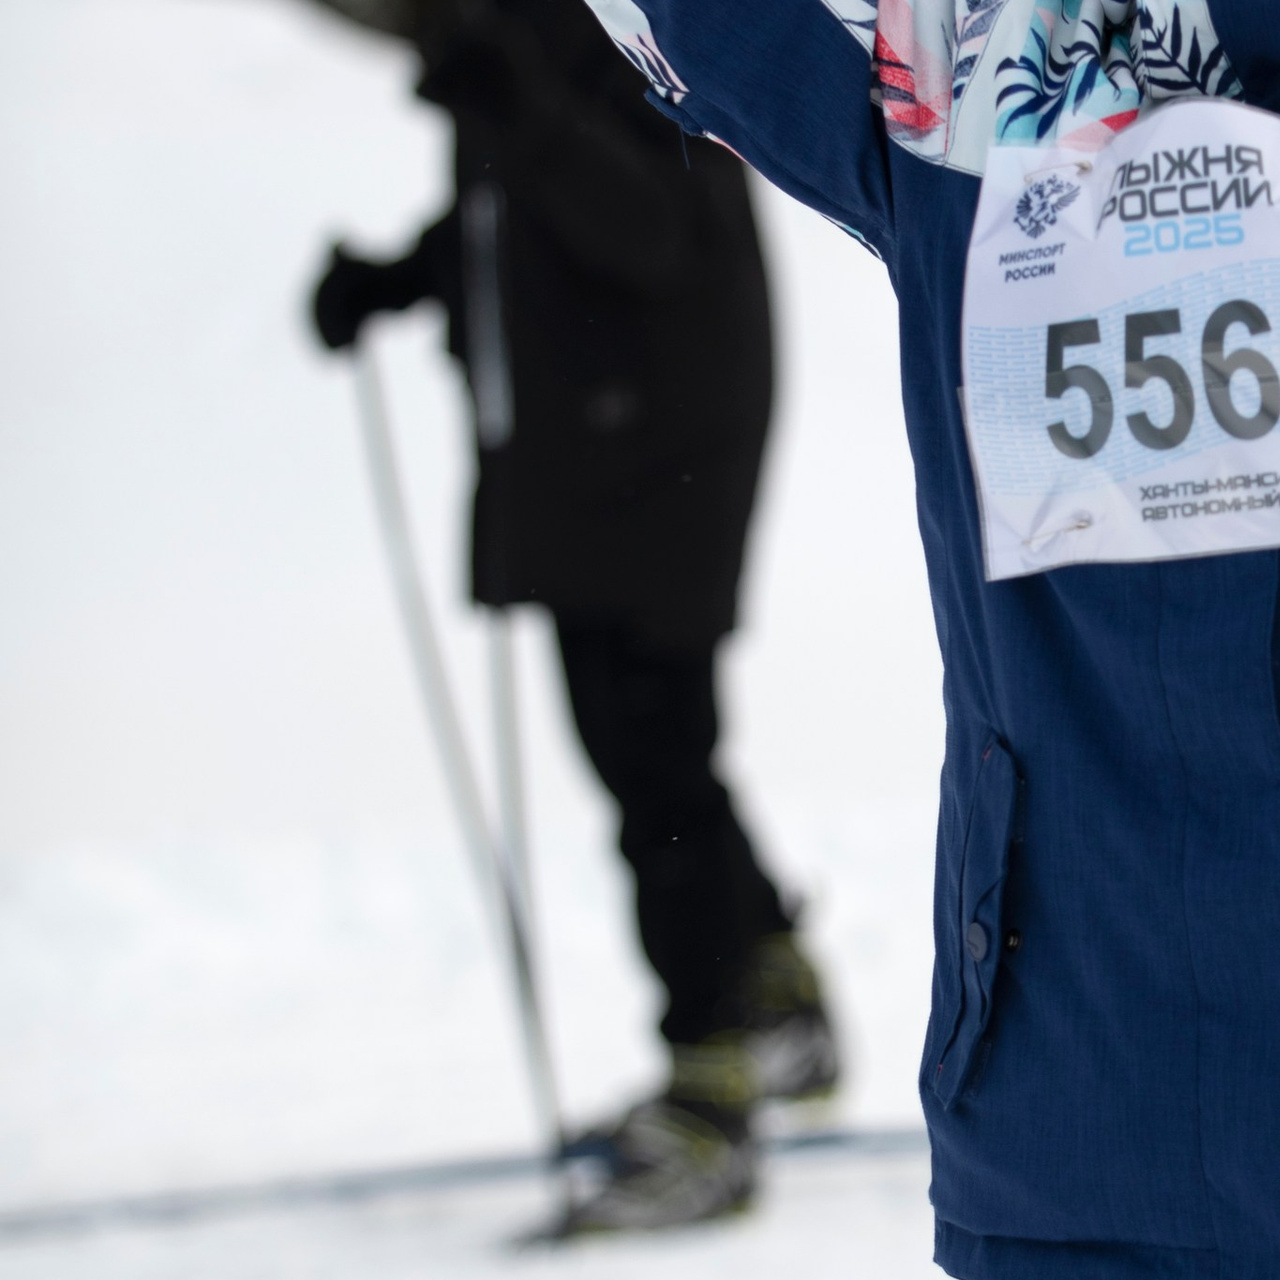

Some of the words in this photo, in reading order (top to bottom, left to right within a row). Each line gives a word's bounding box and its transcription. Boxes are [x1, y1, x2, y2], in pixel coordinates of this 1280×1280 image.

[1109, 144, 1264, 192] ЛЫЖНЯ
[1096, 177, 1274, 235] РОССИИ
[999, 242, 1066, 266] МИНСПОРТ
[1123, 213, 1245, 257] 2025
[1005, 262, 1056, 283] РОССИИ
